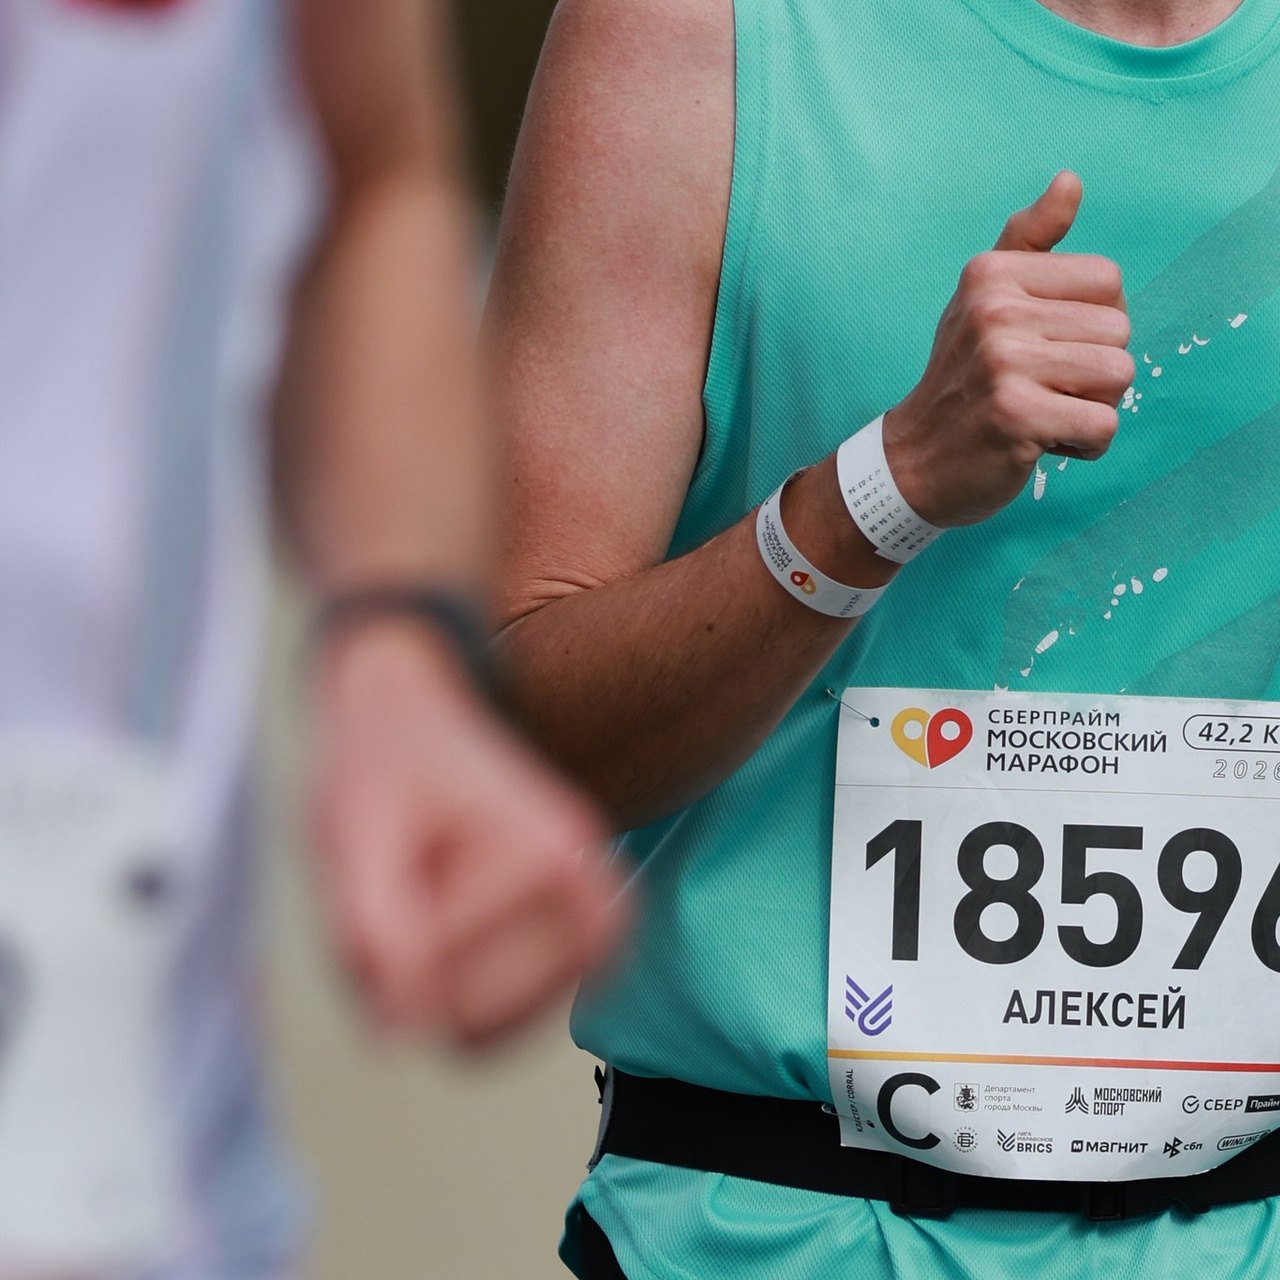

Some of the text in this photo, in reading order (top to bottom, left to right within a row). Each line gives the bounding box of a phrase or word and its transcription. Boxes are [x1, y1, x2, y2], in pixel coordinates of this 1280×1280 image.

[988, 708, 1121, 727] СБЕРПРАЙМ
[987, 729, 1168, 753] МОСКОВСКИЙ
[1198, 722, 1253, 746] 42,2
[986, 753, 1119, 774] МАРАФОН
[1002, 986, 1186, 1030] АЛЕКСЕЙ
[846, 1069, 855, 1099] CORRAL
[984, 1085, 1035, 1094] Департамент
[984, 1095, 1011, 1103] спорта
[1093, 1086, 1162, 1103] МОСКОВСКИЙ
[876, 1072, 941, 1150] C
[984, 1104, 1043, 1112] города Москвы
[1093, 1102, 1125, 1116] СПОРТ
[1203, 1098, 1280, 1111] СБЕР Прайм
[1016, 1142, 1053, 1153] BRICS
[1085, 1141, 1148, 1153] магнит
[1183, 1141, 1202, 1151] сбп
